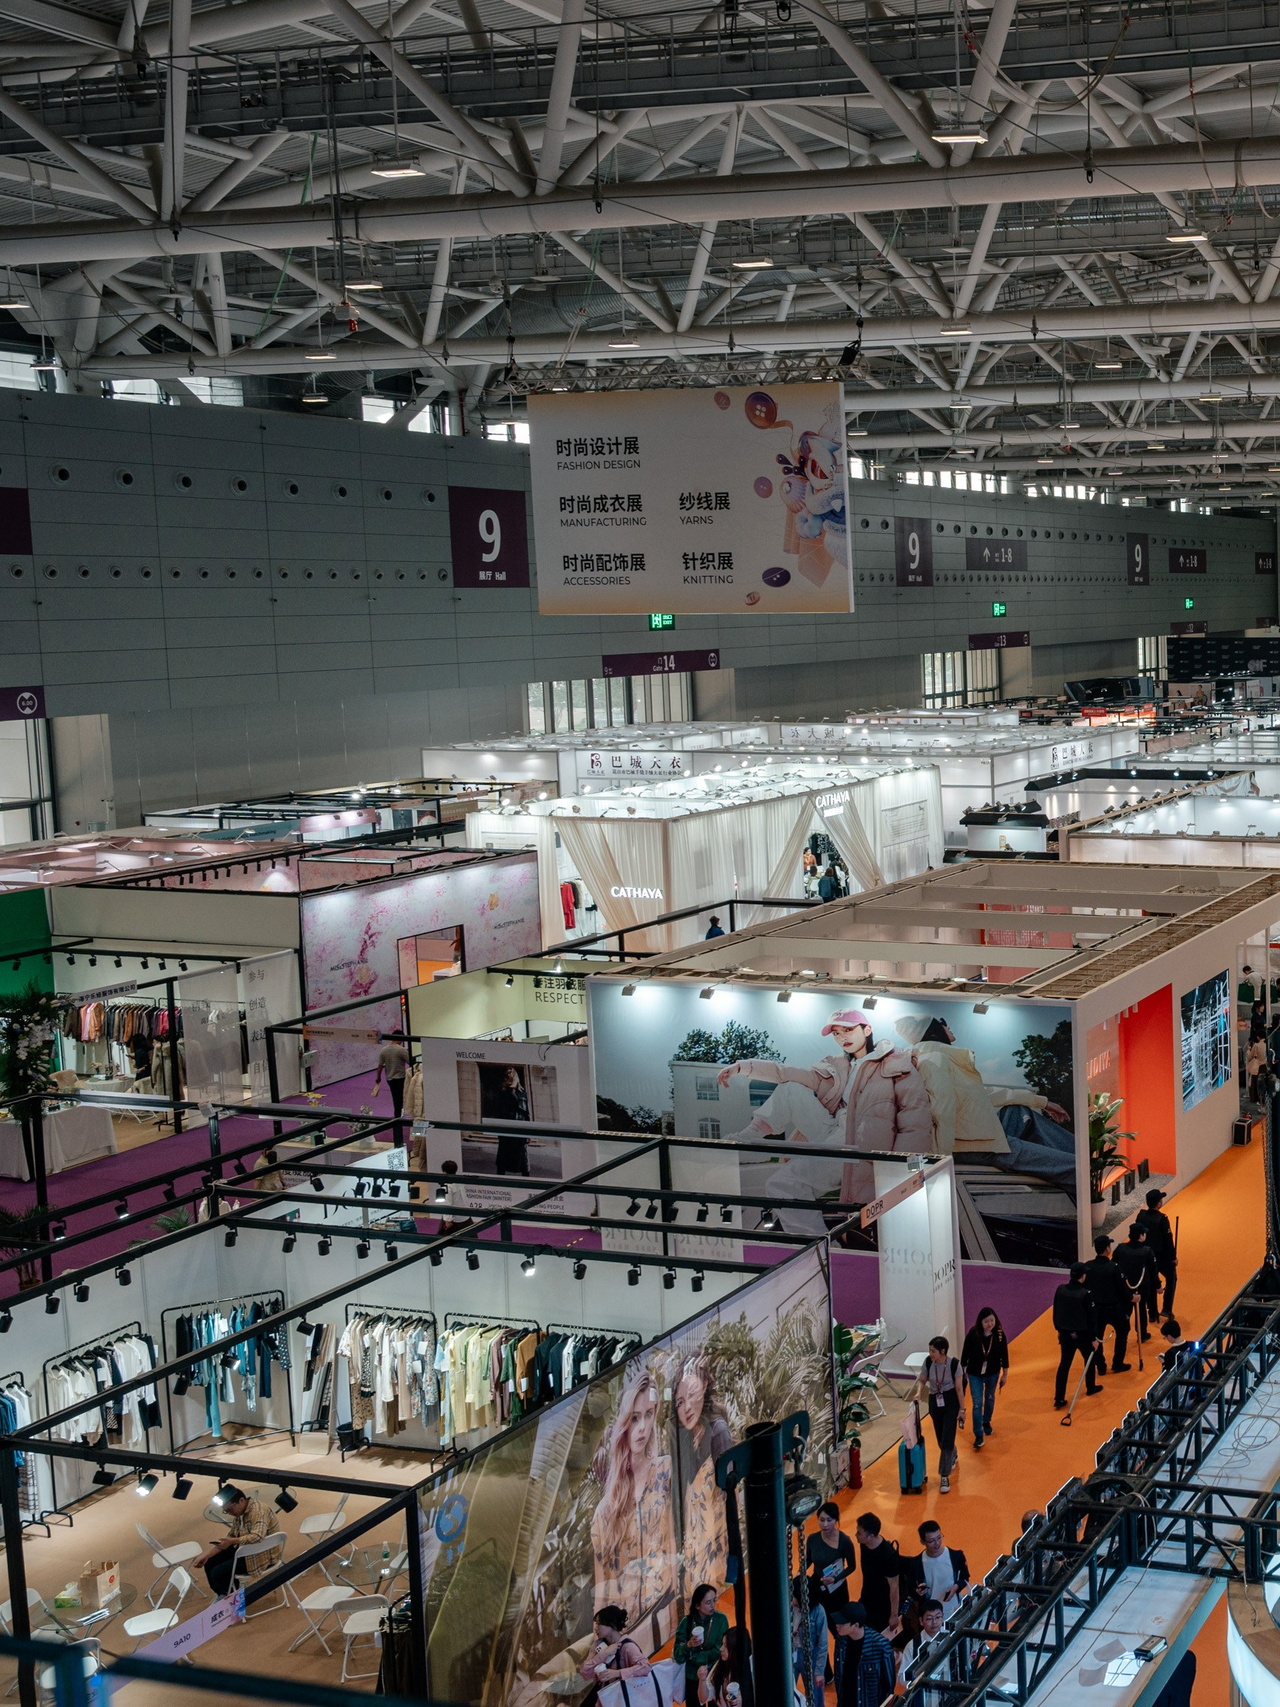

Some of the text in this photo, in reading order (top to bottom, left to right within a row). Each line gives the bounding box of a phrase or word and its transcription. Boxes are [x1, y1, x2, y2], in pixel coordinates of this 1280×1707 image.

[556, 436, 640, 457] 时尚设计展
[556, 459, 641, 471] FASHION DESIGN
[559, 494, 643, 514] 时尚成衣展
[678, 492, 731, 511] 纱线展
[560, 516, 647, 527] MANUFACTURING
[680, 515, 714, 525] YARNS
[478, 509, 501, 563] 9
[908, 532, 920, 569] 9
[1001, 548, 1013, 563] 1-8
[1134, 544, 1142, 572] 9
[562, 553, 646, 572] 时尚配饰展
[682, 552, 734, 571] 针织展
[563, 576, 631, 586] ACCESSORIES
[683, 574, 734, 584] KNITTING
[663, 654, 676, 671] 14
[611, 755, 682, 769] 巴城大衣
[815, 790, 850, 810] CATHAYA
[610, 885, 664, 900] CATHAYA
[535, 991, 585, 1005] RESPECT
[455, 1051, 486, 1060] WELCOME
[866, 1200, 884, 1218] DOPR
